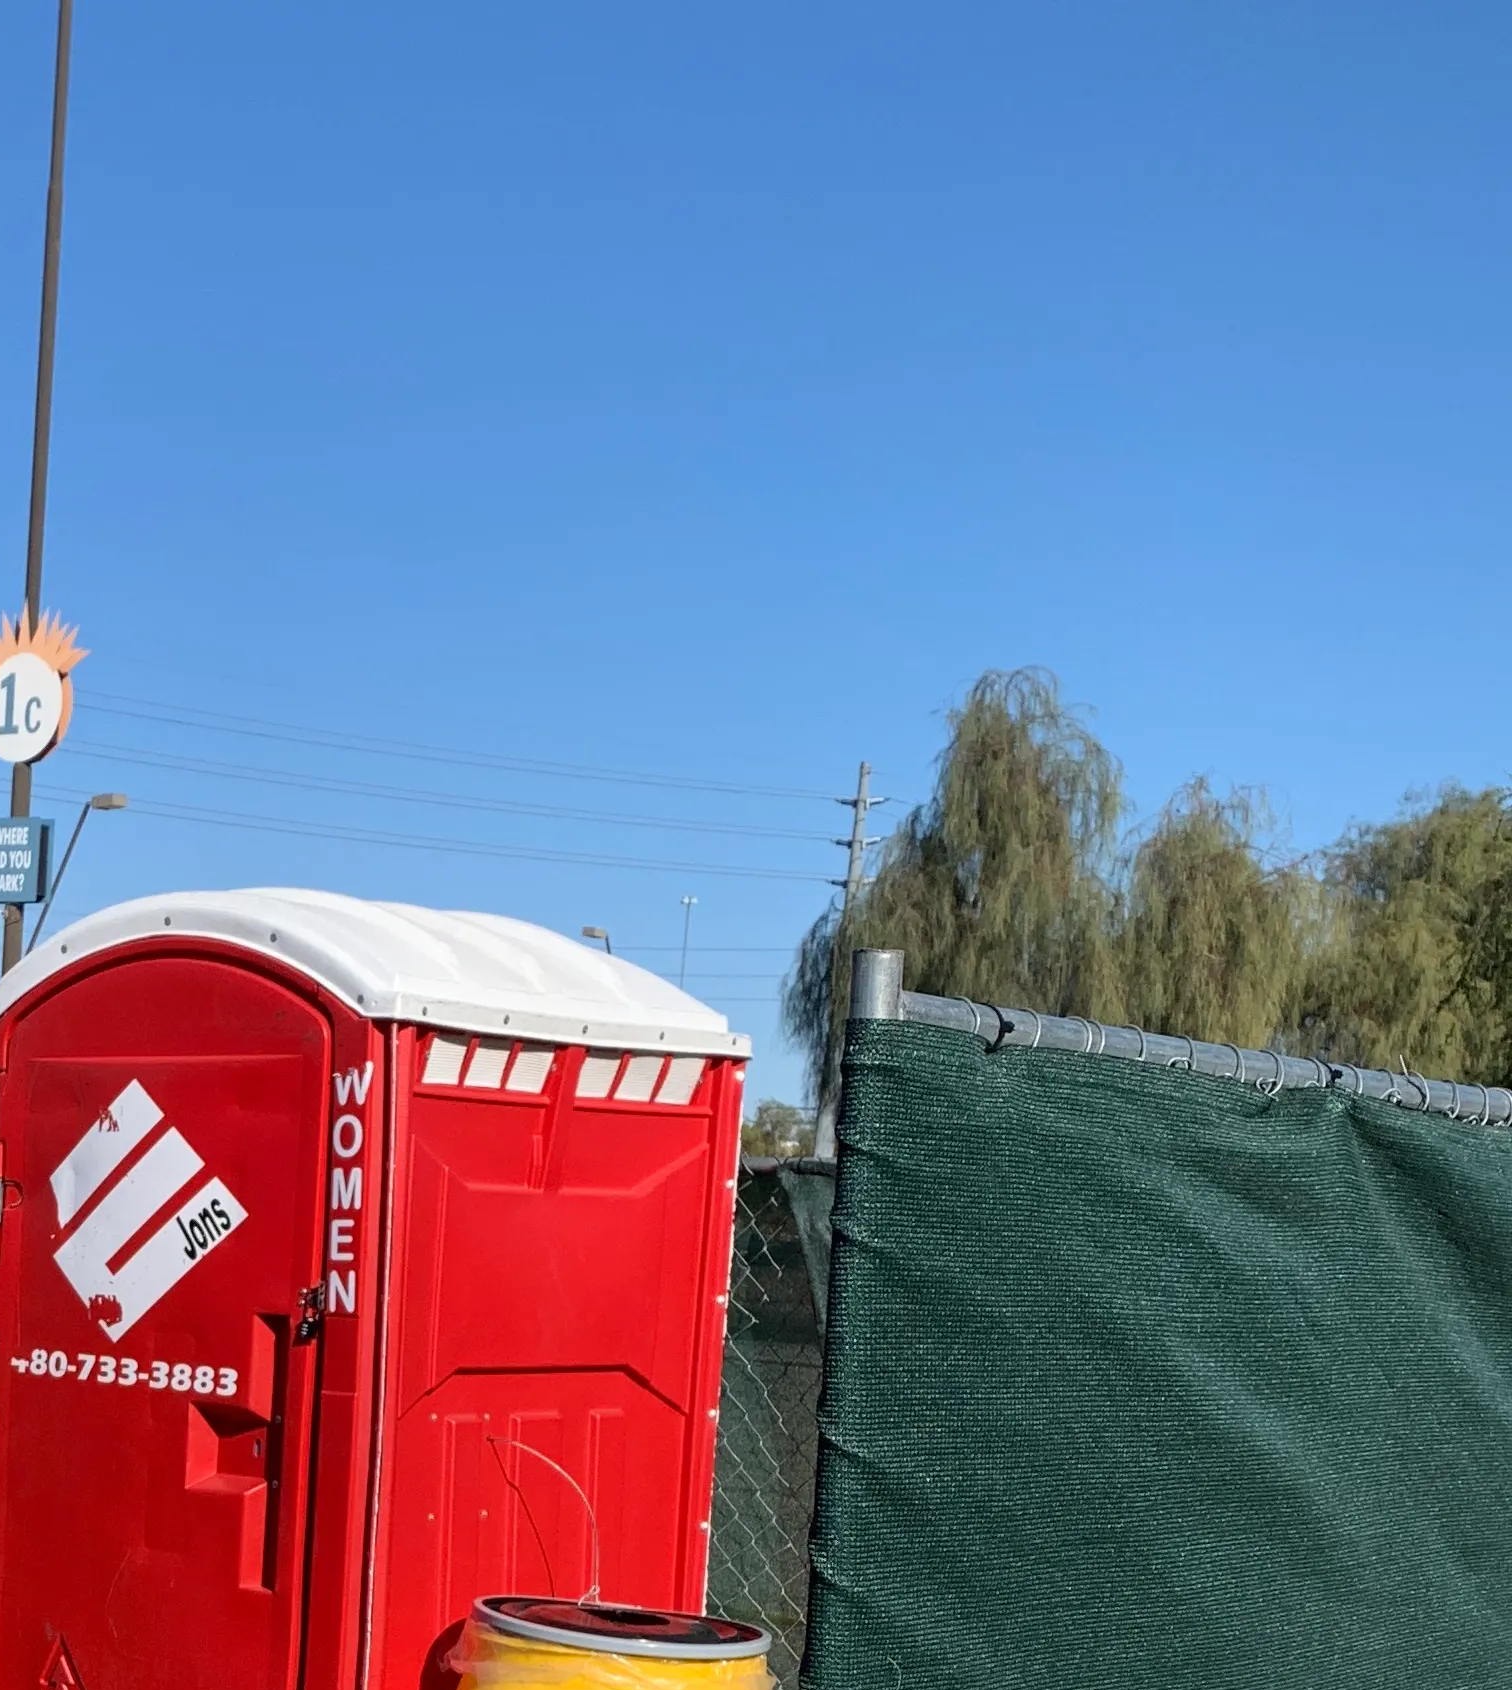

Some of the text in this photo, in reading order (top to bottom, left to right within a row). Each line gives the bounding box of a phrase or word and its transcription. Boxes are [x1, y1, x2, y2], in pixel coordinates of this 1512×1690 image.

[9, 850, 32, 869] YOU
[328, 1060, 374, 1314] WOMEN
[176, 1198, 231, 1260] Jons
